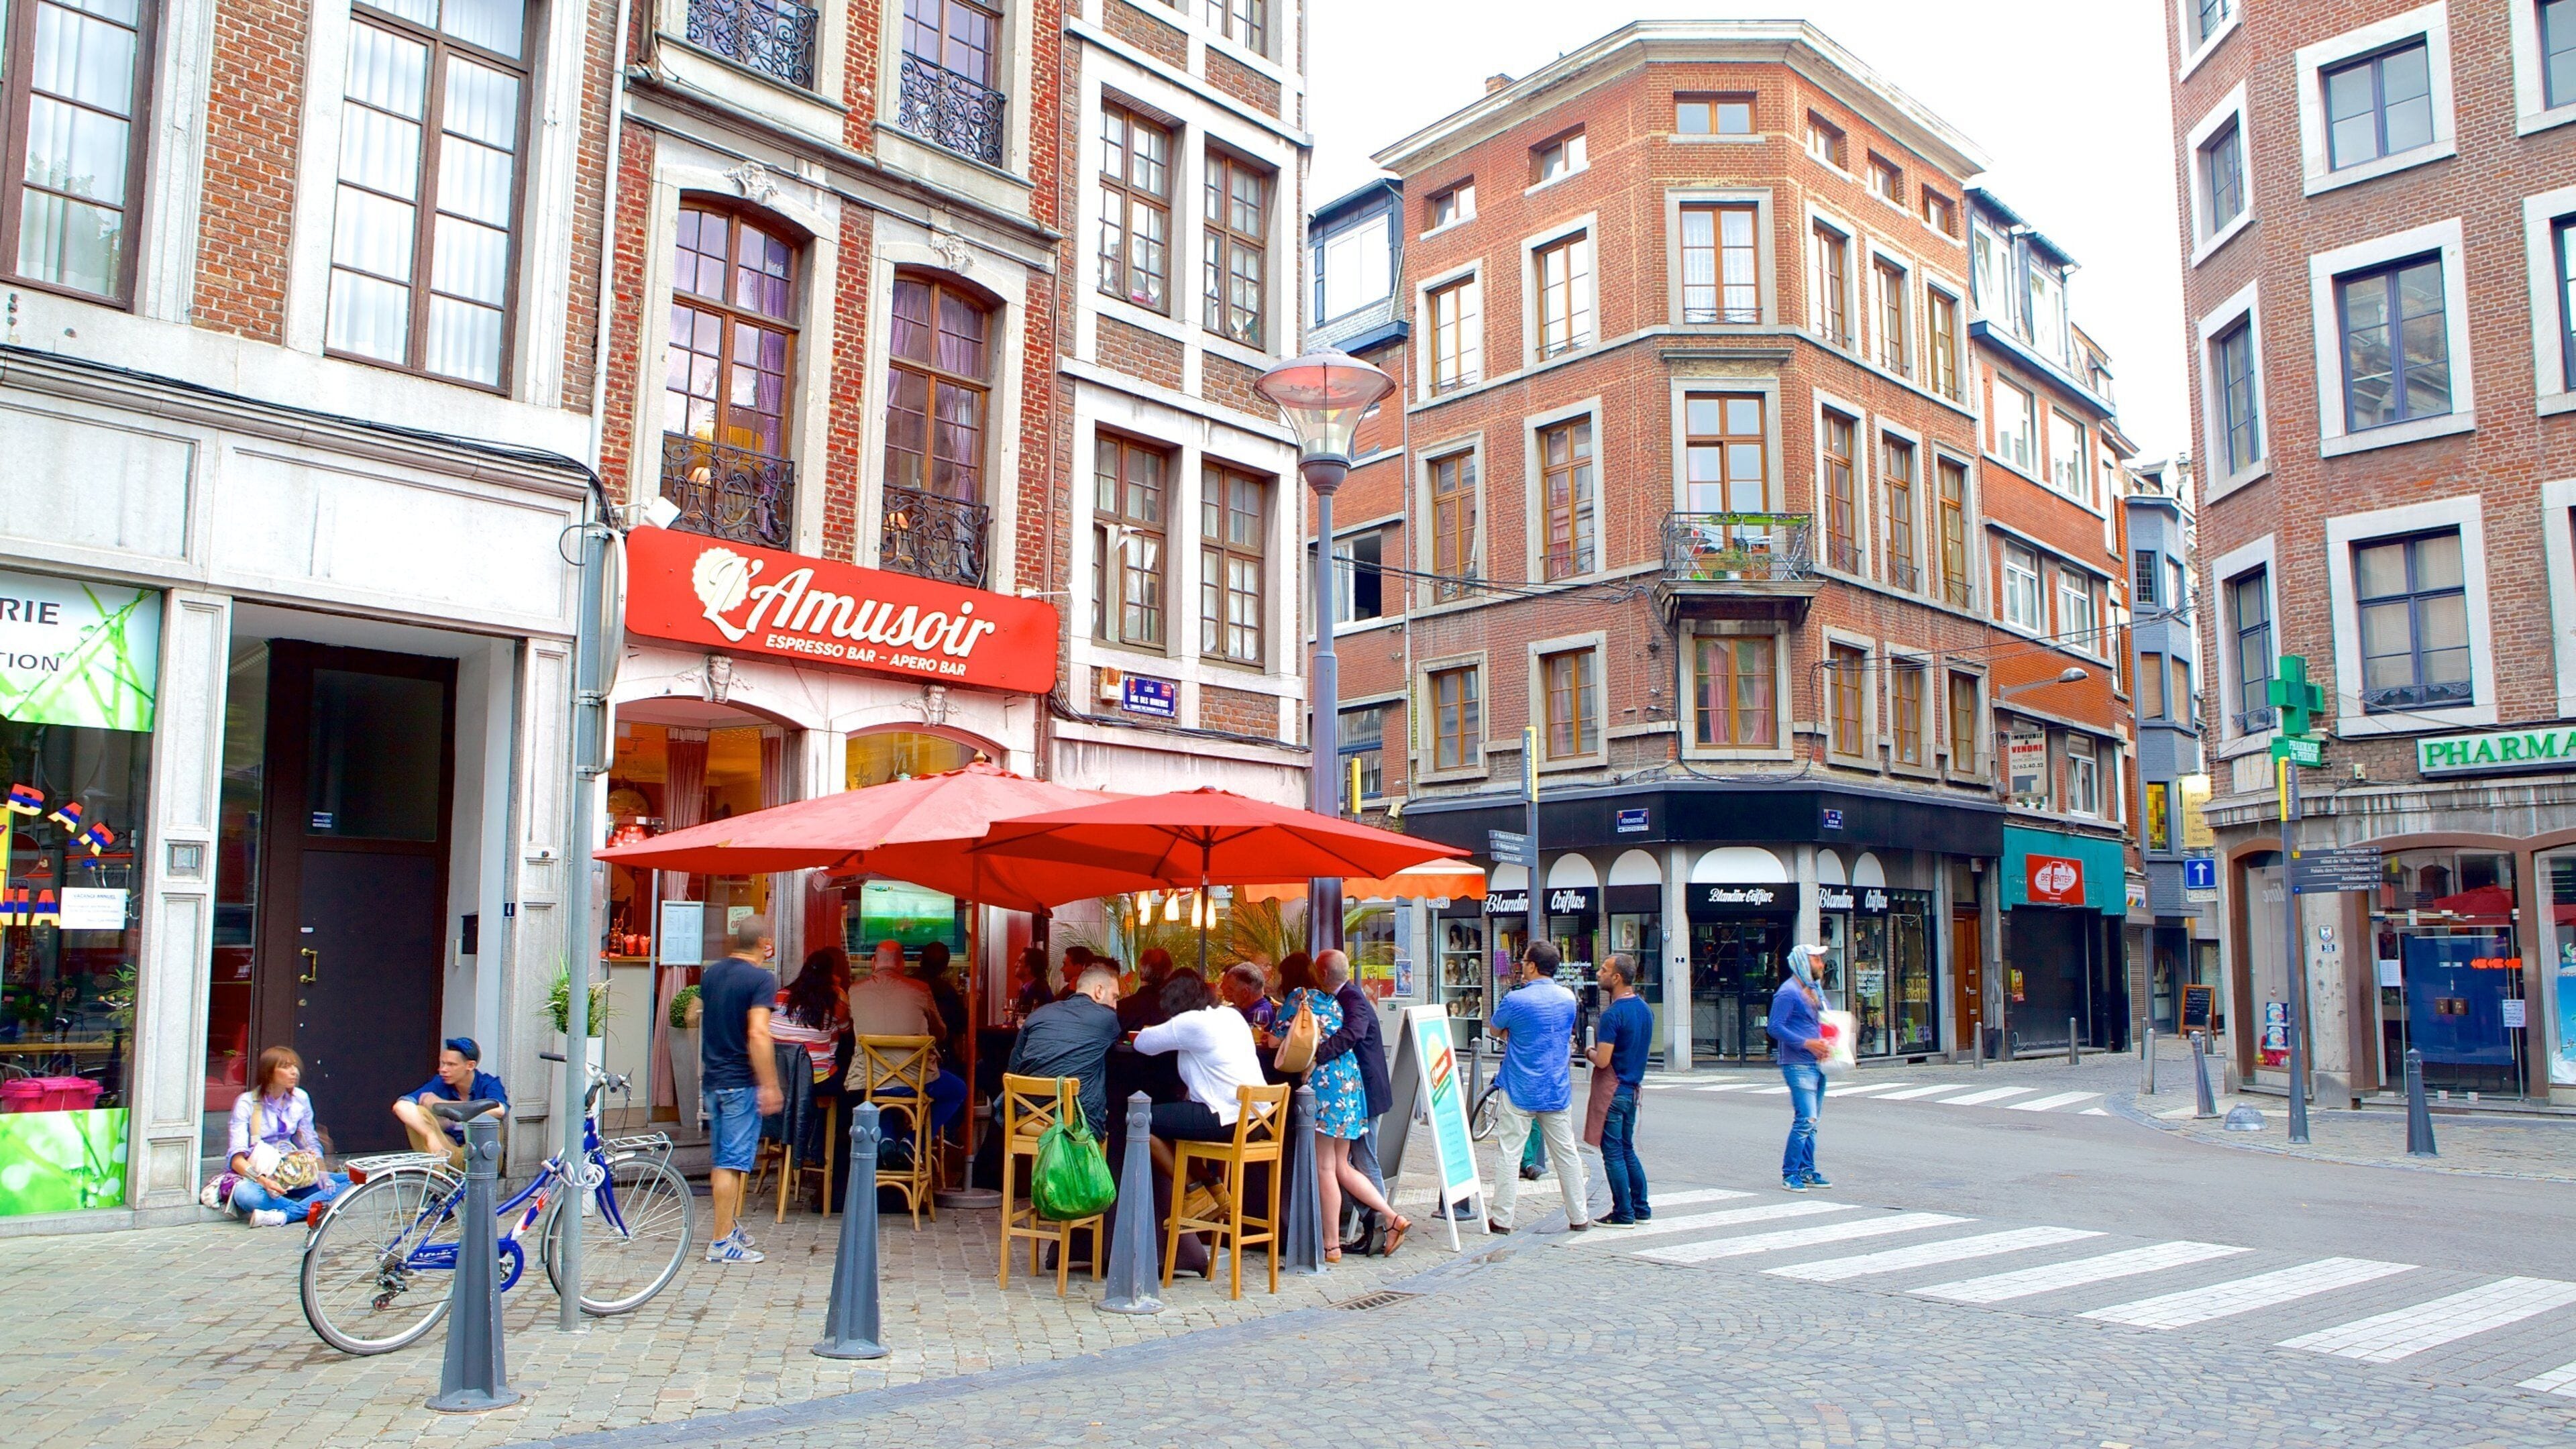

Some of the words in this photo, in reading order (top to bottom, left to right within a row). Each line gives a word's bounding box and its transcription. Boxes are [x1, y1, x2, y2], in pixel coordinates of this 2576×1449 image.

[702, 557, 996, 657] L'Amusoir
[765, 633, 845, 657] ESPRESSO
[846, 646, 877, 663] BAR
[889, 653, 936, 672] APERO
[939, 661, 967, 676] BAR
[2011, 744, 2043, 753] VENDRE
[2424, 731, 2576, 767] PHARMA
[1485, 893, 1528, 913] Blandin
[1551, 890, 1585, 913] Coiffure
[1709, 888, 1746, 903] Blandine
[1745, 888, 1774, 906] Coiffure
[1819, 888, 1854, 909] Blandine
[1865, 889, 1888, 912] Coiffure
[731, 920, 740, 928] OP
